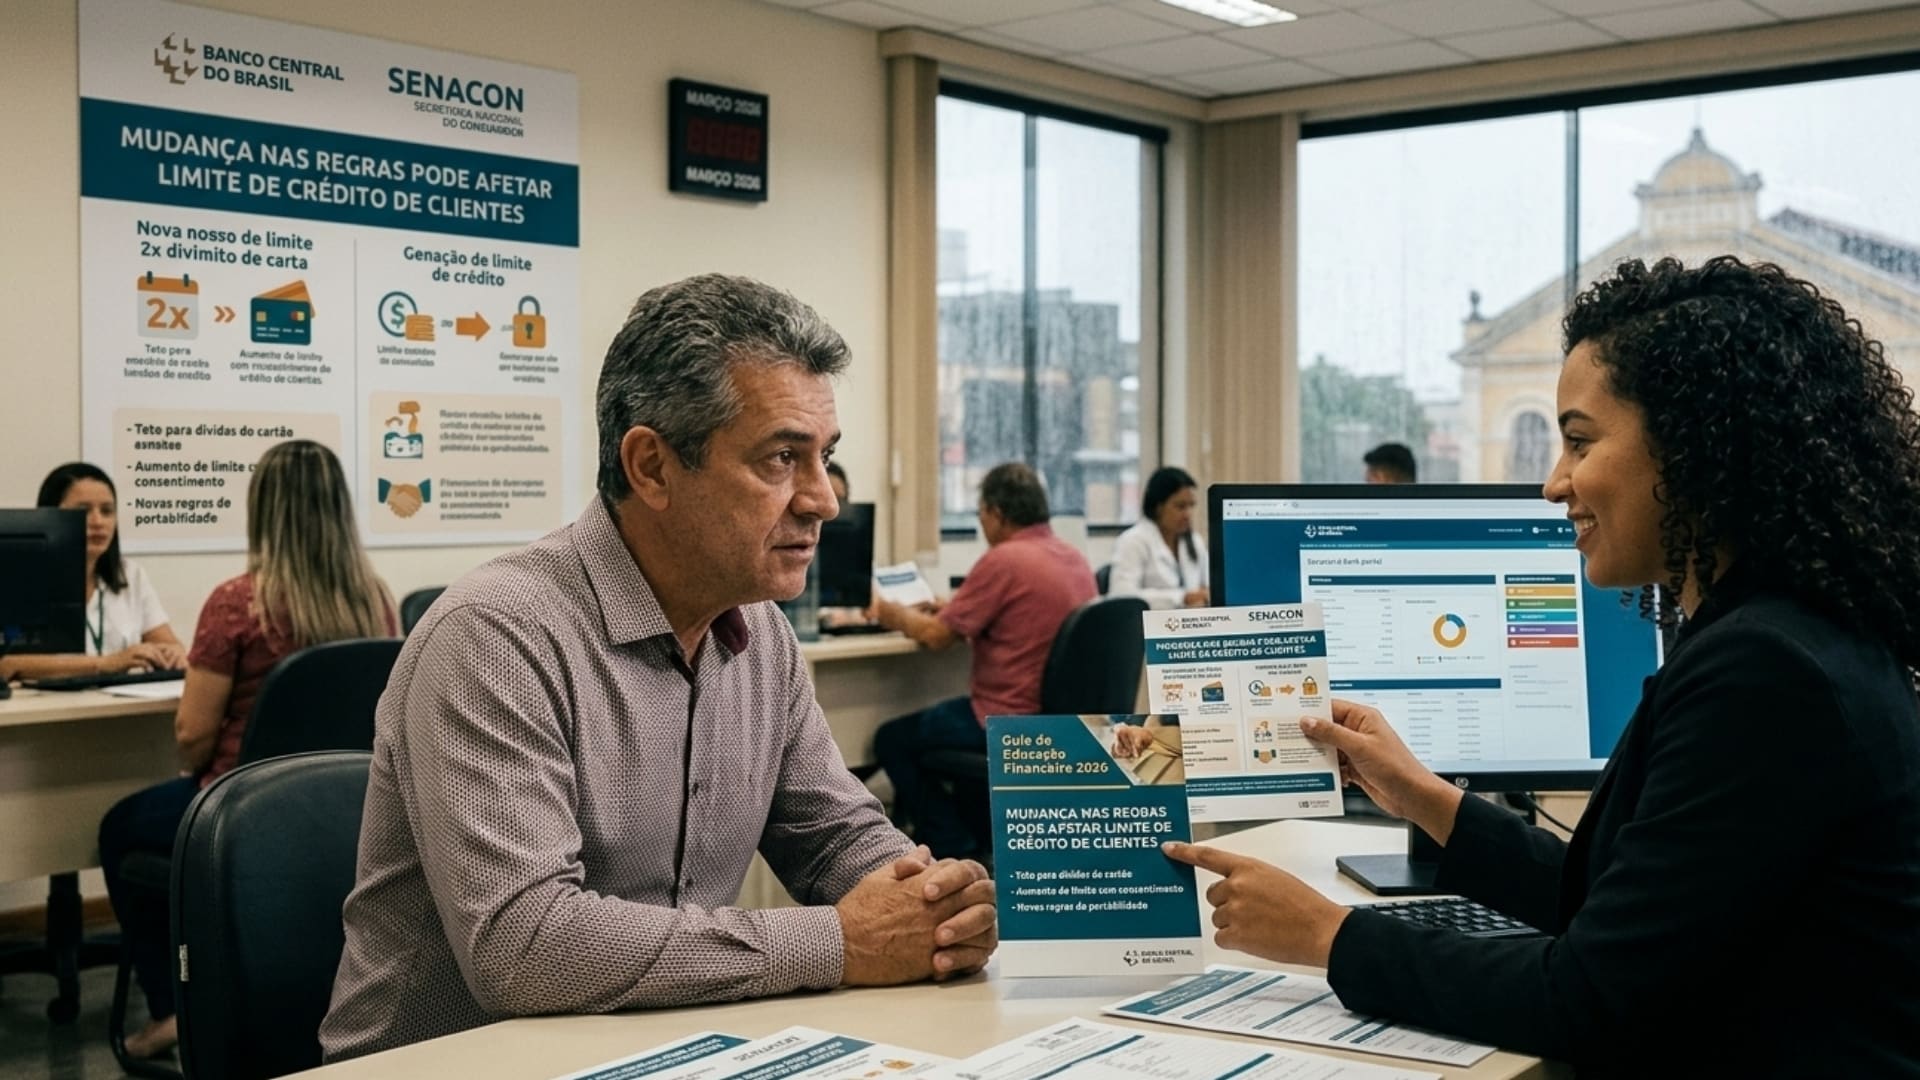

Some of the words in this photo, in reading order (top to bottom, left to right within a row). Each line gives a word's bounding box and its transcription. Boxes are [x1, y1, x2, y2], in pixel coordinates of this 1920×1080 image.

[203, 44, 264, 67] BANCO
[268, 55, 344, 81] CENTRAL
[203, 65, 230, 82] DO
[234, 70, 294, 92] BRASIL
[388, 67, 524, 112] SENACON
[121, 125, 254, 166] MUDANÇA
[260, 143, 309, 170] NAS
[316, 151, 405, 181] REGRAS
[411, 163, 470, 189] PODE
[475, 172, 553, 199] AFETAR
[158, 163, 242, 193] LIMITE
[249, 173, 281, 198] DE
[287, 175, 387, 209] CRÉDITO
[393, 190, 422, 213] DE
[427, 196, 525, 225] CLIENTES
[137, 220, 182, 239] Nova
[187, 226, 236, 244] nosso
[241, 230, 261, 246] de
[266, 231, 313, 250] limite
[140, 241, 161, 257] 2x
[166, 243, 237, 265] divimito
[241, 250, 261, 266] de
[266, 253, 308, 270] carta
[403, 246, 468, 267] Genação
[471, 252, 489, 267] de
[492, 253, 532, 271] limite
[432, 267, 450, 282] de
[454, 269, 505, 287] crédito
[146, 297, 190, 330] 2x
[165, 425, 192, 437] para
[240, 425, 254, 437] do
[135, 461, 191, 472] Aumento
[194, 461, 207, 472] de
[211, 460, 245, 472] limite
[135, 476, 225, 488] consentimento
[135, 498, 172, 509] Novas
[217, 497, 231, 509] de
[1076, 762, 1109, 773] 2026
[1081, 807, 1110, 819] NAS
[1071, 838, 1090, 849] DE
[1093, 836, 1158, 849] CLIENTES
